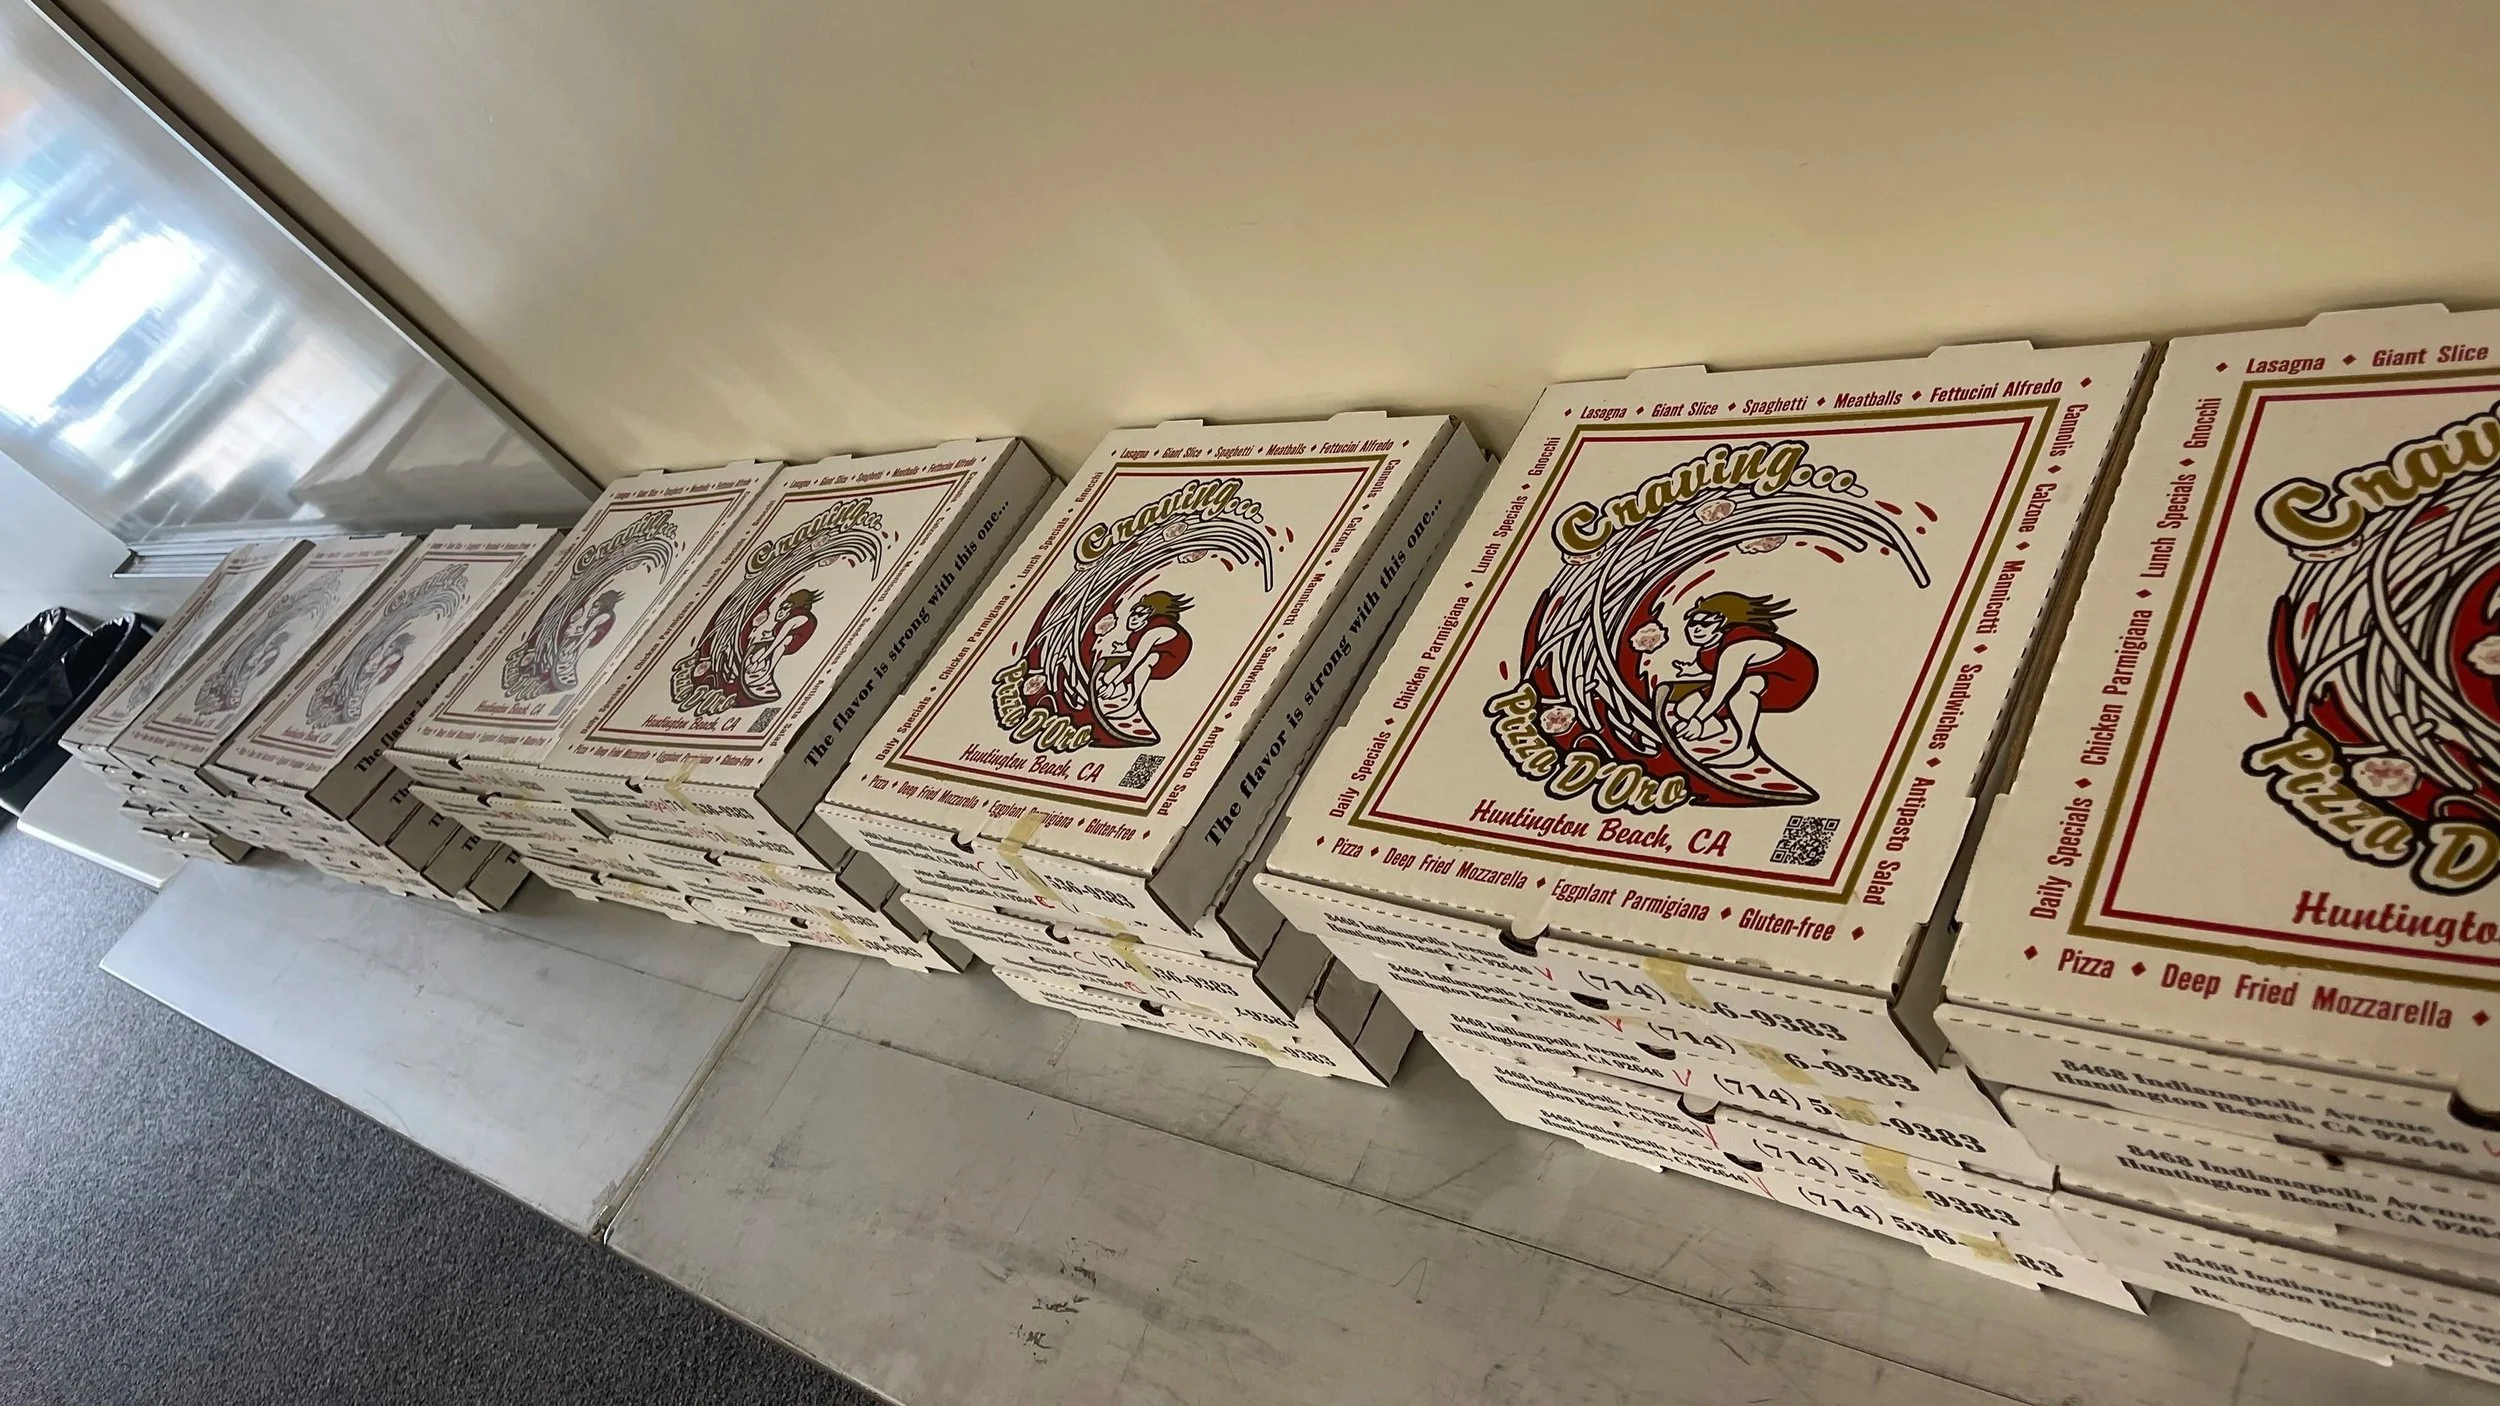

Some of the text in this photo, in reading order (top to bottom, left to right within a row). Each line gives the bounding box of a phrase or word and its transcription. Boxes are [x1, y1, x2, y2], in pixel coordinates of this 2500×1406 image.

[2246, 345, 2490, 375] Lasagna Giant Slice
[1580, 378, 2063, 421] Lasagna Giant Slice Spaghetti Meatballs Fettucini Alfredo
[1120, 439, 1394, 459] Lasagna Giant Slice Spaghetti Meatballs Fettucini Alfredo
[803, 501, 1010, 769] The flavor is strong with this one...
[876, 471, 1104, 762] Daily Specials Chicken Parmigiana Lunch Specials Gnocchi
[1157, 459, 1401, 816] Cannolis Calzone Mannicotti Sandwiches Antipasto Salad
[1329, 436, 1561, 818] Daily Specials Chicken Parmigiana Lunch Specials Gnocchi
[1204, 499, 1442, 848] The flavor is strong with this one...
[1863, 403, 2089, 906] Cannolis Calzone Mannicotti Sandwiches Antipasto Salad
[2029, 397, 2222, 920] Daily Specials Chicken Parmigiana Lunch Specials Gnocchi
[992, 659, 1092, 753] Pizza D'Oro
[354, 747, 383, 773] The
[959, 743, 1105, 783] Huntington Beach, CA
[1488, 683, 1687, 812] Pizza D'Oro
[868, 774, 1137, 842] Pizza Deep Fried Mozzarella Eggplant Pigiana Gluten-free
[1469, 799, 1733, 857] Huntington Beach, CA
[2250, 727, 2416, 862] Pizza
[1331, 837, 1836, 941] Pizza Deep Fried Mozzarella Eggplant Parmigiana Gluten-free
[1324, 912, 1508, 961] 8468 Indianapolis Avenue
[1326, 922, 1534, 975] Huntington Beach, CA 92646
[1388, 962, 1576, 1011] 8468 Indianapolis Avenue
[1389, 971, 1600, 1025] Huntington Beach, CA 92646
[1578, 970, 1848, 1042] (714) 6-9383
[2058, 947, 2452, 1029] Pizza Deep Fried Mozzarella
[1241, 1035, 1337, 1067] 5-9383
[1450, 1012, 1641, 1063] 8468 Indianapolis Avenue
[1451, 1022, 1665, 1078] Huntington Beach, CA 92646
[1647, 1021, 1920, 1092] (714) 6-9383
[1713, 1073, 1801, 1111] (714)
[2051, 1071, 2470, 1154] Huntington Beach, CA 92646
[2061, 1059, 2435, 1134] 8468 Indianapolis Avenue
[1753, 1138, 1839, 1177] (714)
[2115, 1155, 2427, 1227] Huntington Beach, CA
[2127, 1144, 2497, 1226] 8468 Indianapolis Avenue
[1798, 1187, 2065, 1278] (714) 536-83
